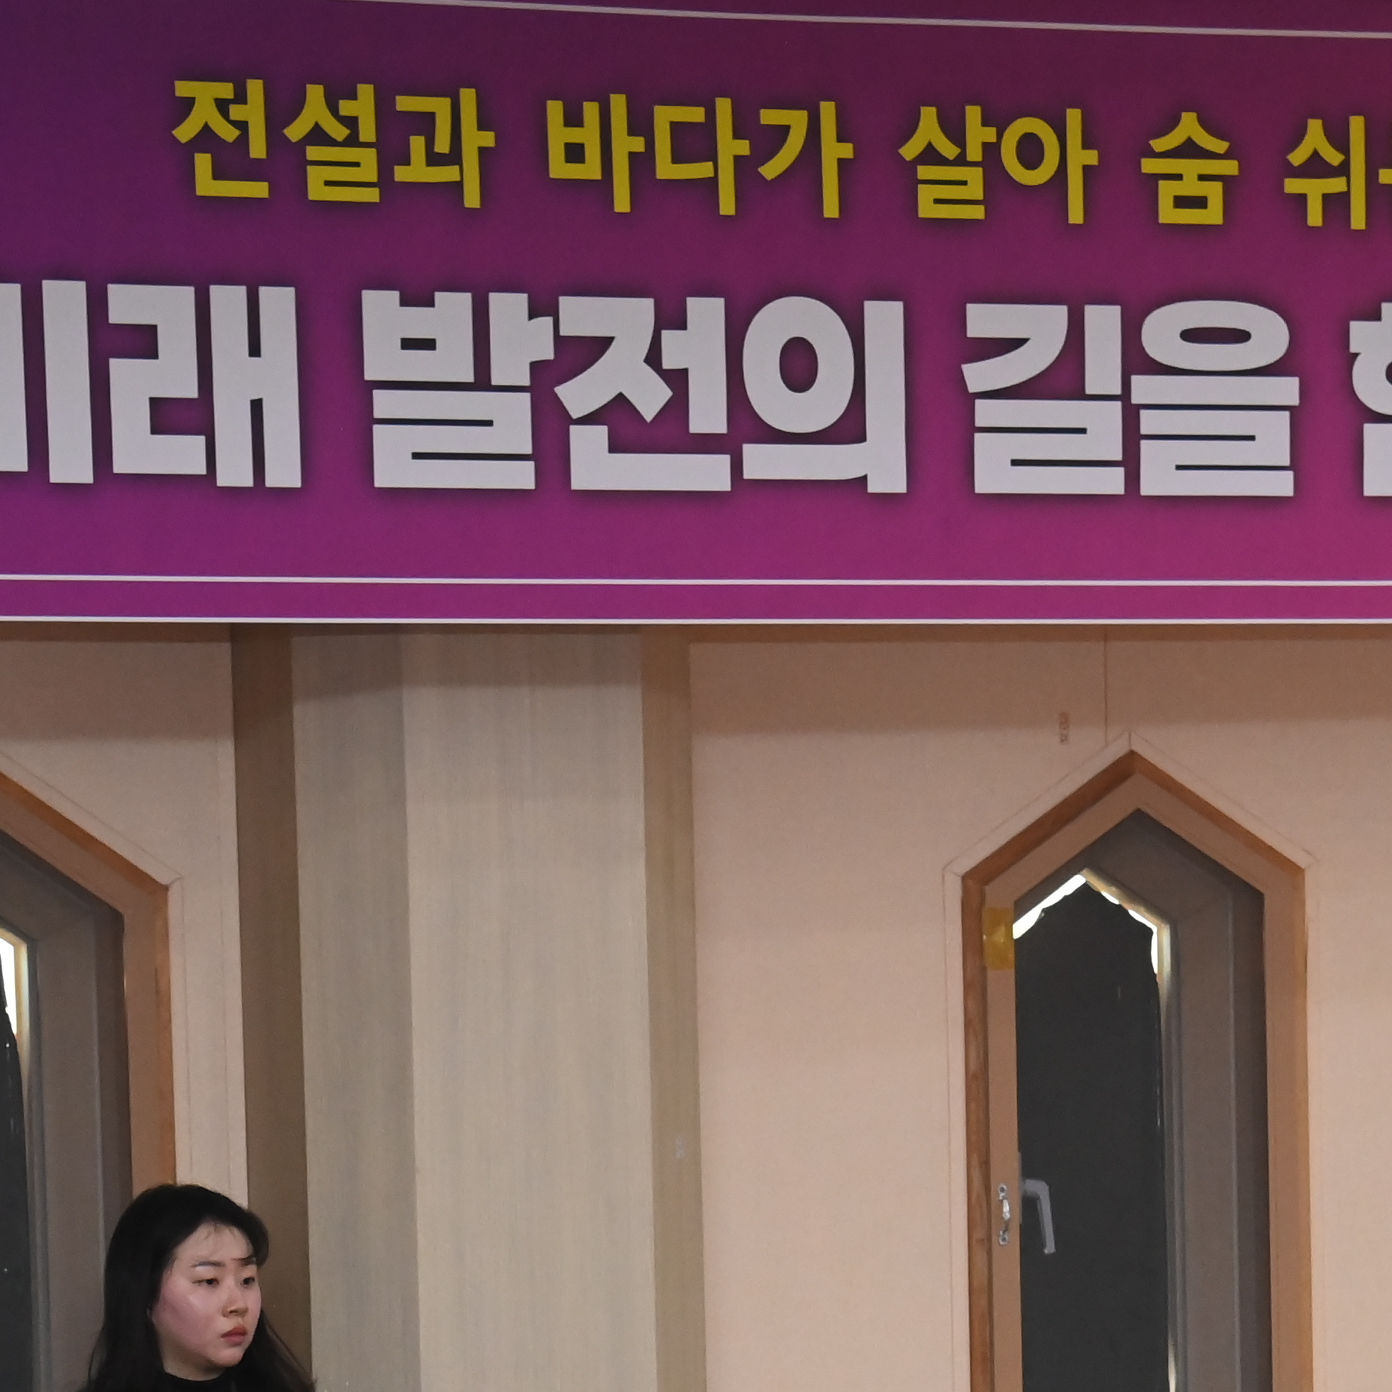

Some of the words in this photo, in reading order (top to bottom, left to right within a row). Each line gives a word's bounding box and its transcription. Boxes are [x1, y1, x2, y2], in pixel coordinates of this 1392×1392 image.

[173, 79, 496, 209] 전설과
[547, 93, 854, 219] 바다가
[900, 105, 1099, 225] 살아
[1141, 111, 1239, 226] 숨
[361, 289, 908, 494] 발전의
[961, 300, 1300, 497] 길을
